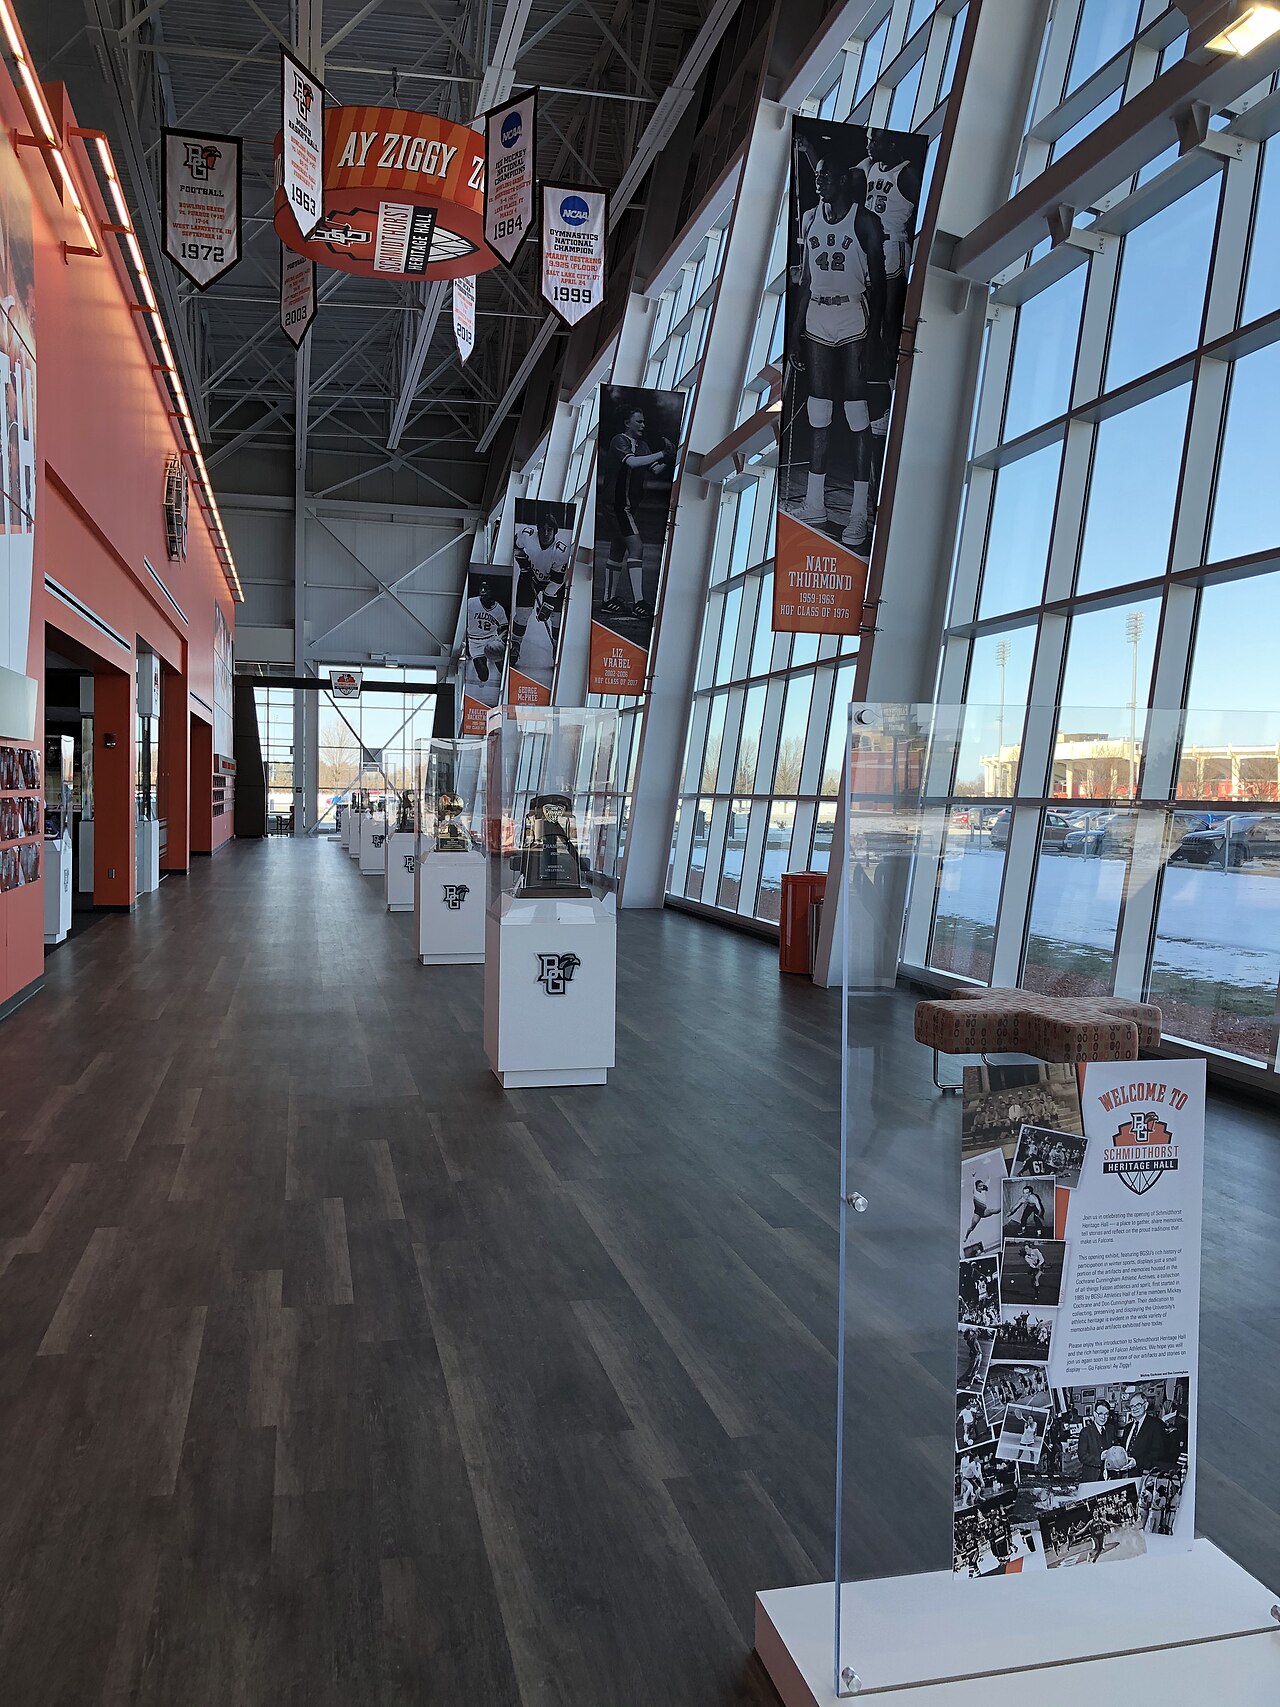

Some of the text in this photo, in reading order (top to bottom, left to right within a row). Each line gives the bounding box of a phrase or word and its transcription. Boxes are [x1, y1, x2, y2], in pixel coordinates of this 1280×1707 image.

[337, 131, 378, 168] AY
[377, 132, 458, 178] ZIGGY
[180, 184, 224, 198] FOOTBALL
[292, 184, 316, 217] 1963
[562, 209, 588, 219] NCAA
[494, 214, 522, 240] 1984
[379, 204, 410, 272] SCHMIDTHORST
[550, 228, 598, 241] GYMNASTICS
[408, 214, 432, 271] HERITAGE HALL
[554, 237, 594, 248] NATIONAL
[554, 244, 594, 254] CHAMPION
[182, 243, 224, 263] 1972
[815, 252, 846, 272] 42
[553, 286, 592, 304] 1999
[285, 306, 308, 327] 2003
[806, 556, 837, 572] NATE
[788, 572, 852, 591] THURMOND
[800, 592, 835, 604] 1959-1963
[780, 604, 794, 616] HOF
[797, 606, 819, 617] CLASS
[822, 608, 831, 618] OF
[478, 620, 492, 631] 12
[612, 648, 624, 658] LIZ
[604, 658, 630, 668] VRABEL
[518, 686, 538, 694] GEORGE
[1097, 1082, 1189, 1112] WELCOME TO
[1104, 1145, 1179, 1161] SCHMIDTHORST
[1032, 1160, 1044, 1174] 67
[1108, 1160, 1174, 1172] HERITAGE HALL
[1103, 1212, 1126, 1220] celebrating
[1094, 1308, 1115, 1316] preserving
